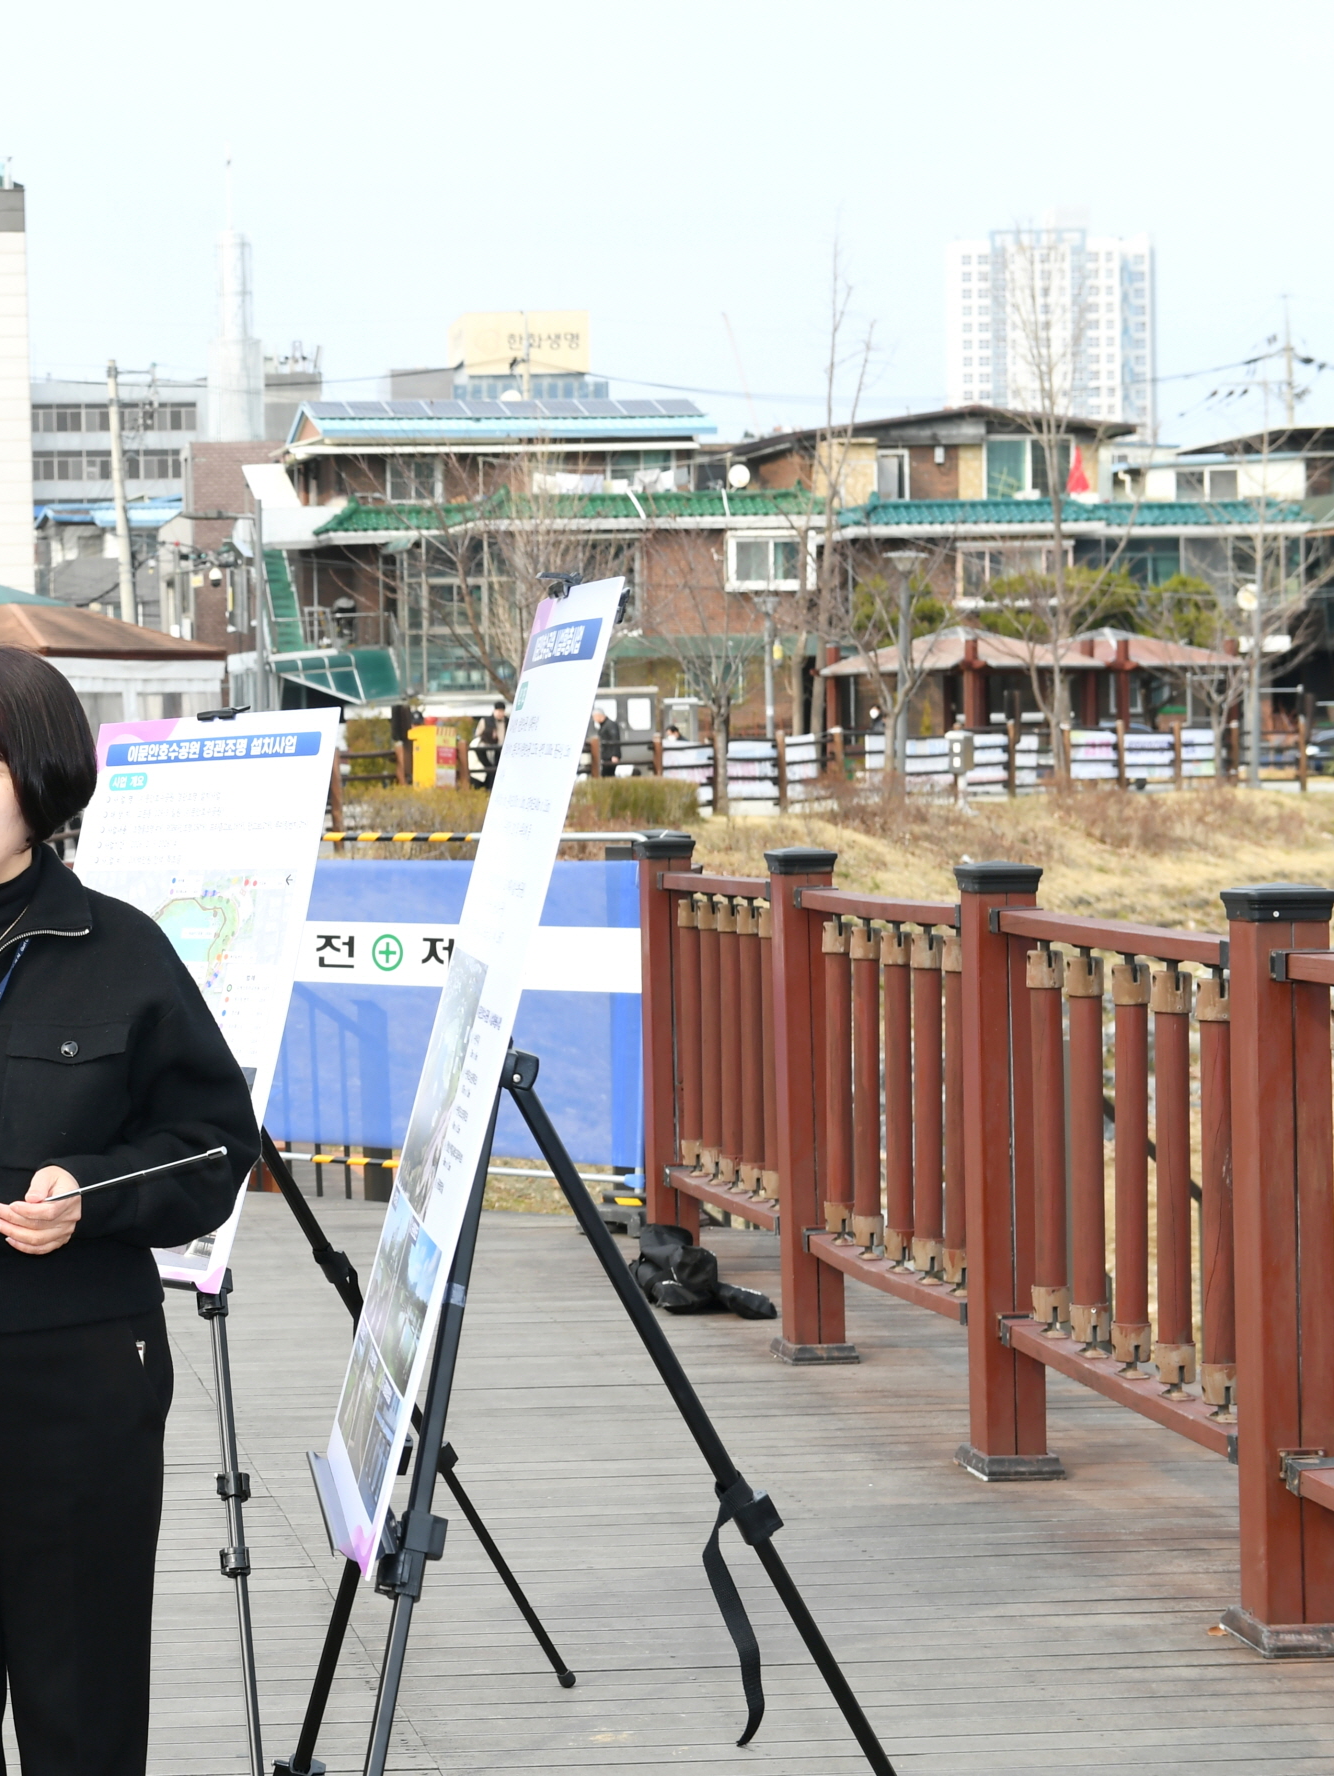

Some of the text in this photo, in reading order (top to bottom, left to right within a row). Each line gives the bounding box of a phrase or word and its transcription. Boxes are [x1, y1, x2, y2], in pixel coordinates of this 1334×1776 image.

[507, 332, 580, 351] 한화생명
[127, 735, 298, 763] 이문안호수공원 경관조명 설치사업
[112, 775, 145, 789] 사업 개요
[315, 934, 356, 969] 전
